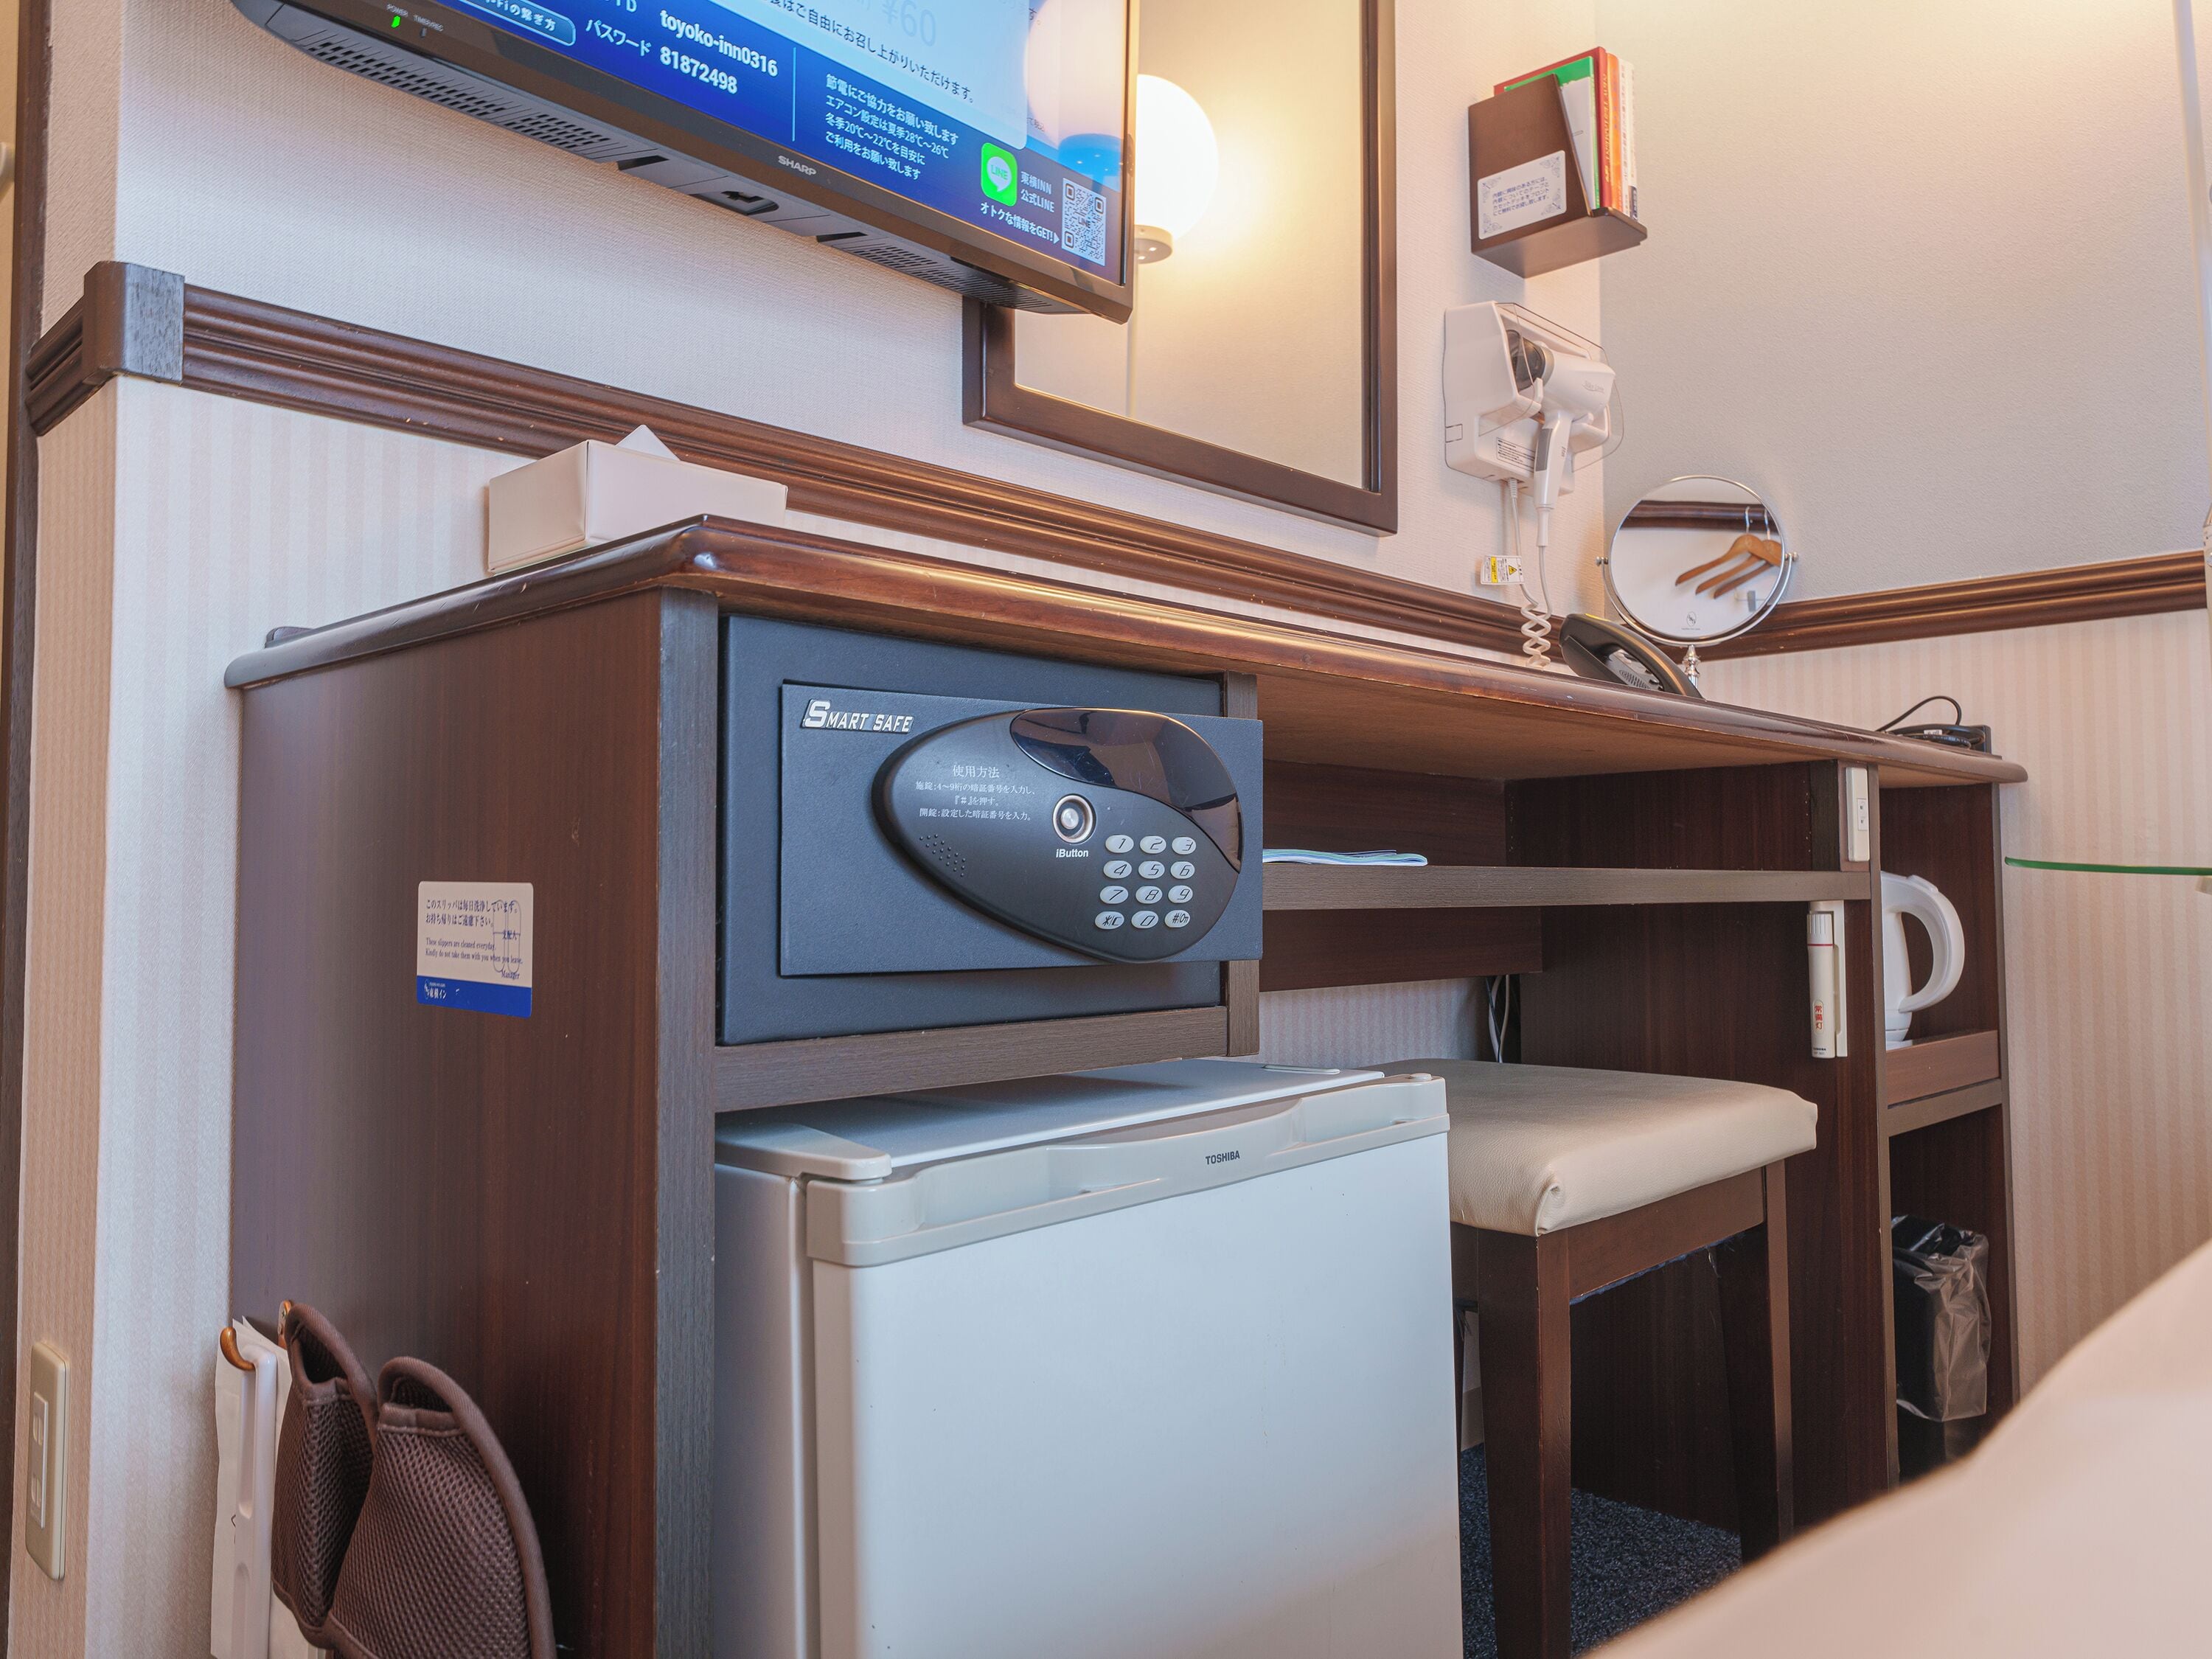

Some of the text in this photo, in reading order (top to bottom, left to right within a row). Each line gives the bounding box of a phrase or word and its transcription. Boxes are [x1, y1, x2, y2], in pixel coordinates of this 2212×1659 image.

[659, 10, 779, 77] toyoko-inn0316
[585, 19, 738, 95] パスワード 81872498
[826, 73, 959, 145] 節電にご協力をお願い致します
[826, 131, 921, 180] ご利用をお願い致します
[778, 155, 817, 175] SHARP
[990, 164, 1008, 181] LINE
[1020, 171, 1052, 195] 東横INN
[1020, 189, 1054, 213] 公式LINE
[804, 700, 914, 732] SMART SAFE
[952, 765, 1000, 779] 使用方法
[1118, 838, 1194, 852] 1 2 3
[1055, 849, 1089, 858] iButton
[1113, 863, 1192, 877] 4 5 6
[1109, 888, 1191, 901] 7 8 9
[425, 913, 494, 928] お持ち帰りはご遠慮下さい。
[1140, 915, 1155, 927] 0
[438, 938, 453, 947] slippers
[461, 939, 476, 948] cleaned
[425, 948, 437, 957] Kindly
[439, 949, 443, 957] do
[451, 950, 459, 959] take
[461, 951, 470, 959] them
[490, 954, 501, 962] when
[501, 970, 520, 980] Manager
[1205, 1150, 1240, 1165] TOSHIBA
